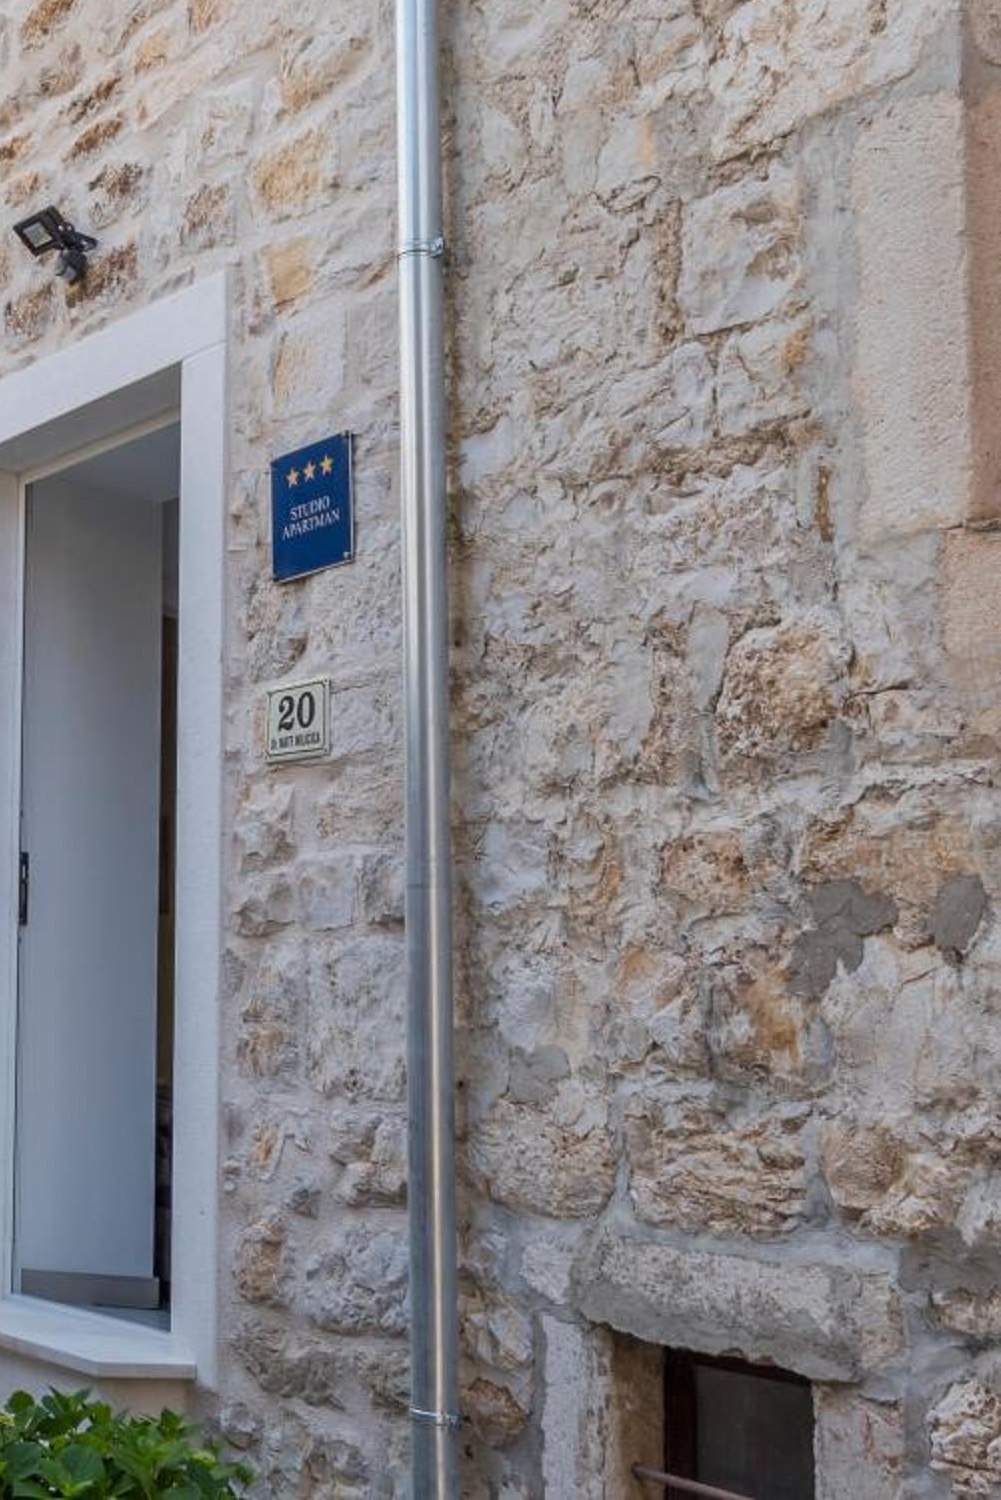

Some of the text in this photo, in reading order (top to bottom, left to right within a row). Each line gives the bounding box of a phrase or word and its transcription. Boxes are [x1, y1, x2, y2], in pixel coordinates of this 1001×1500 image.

[282, 508, 341, 540] APARTMAN
[290, 495, 331, 521] STUDIO
[278, 691, 315, 732] 20
